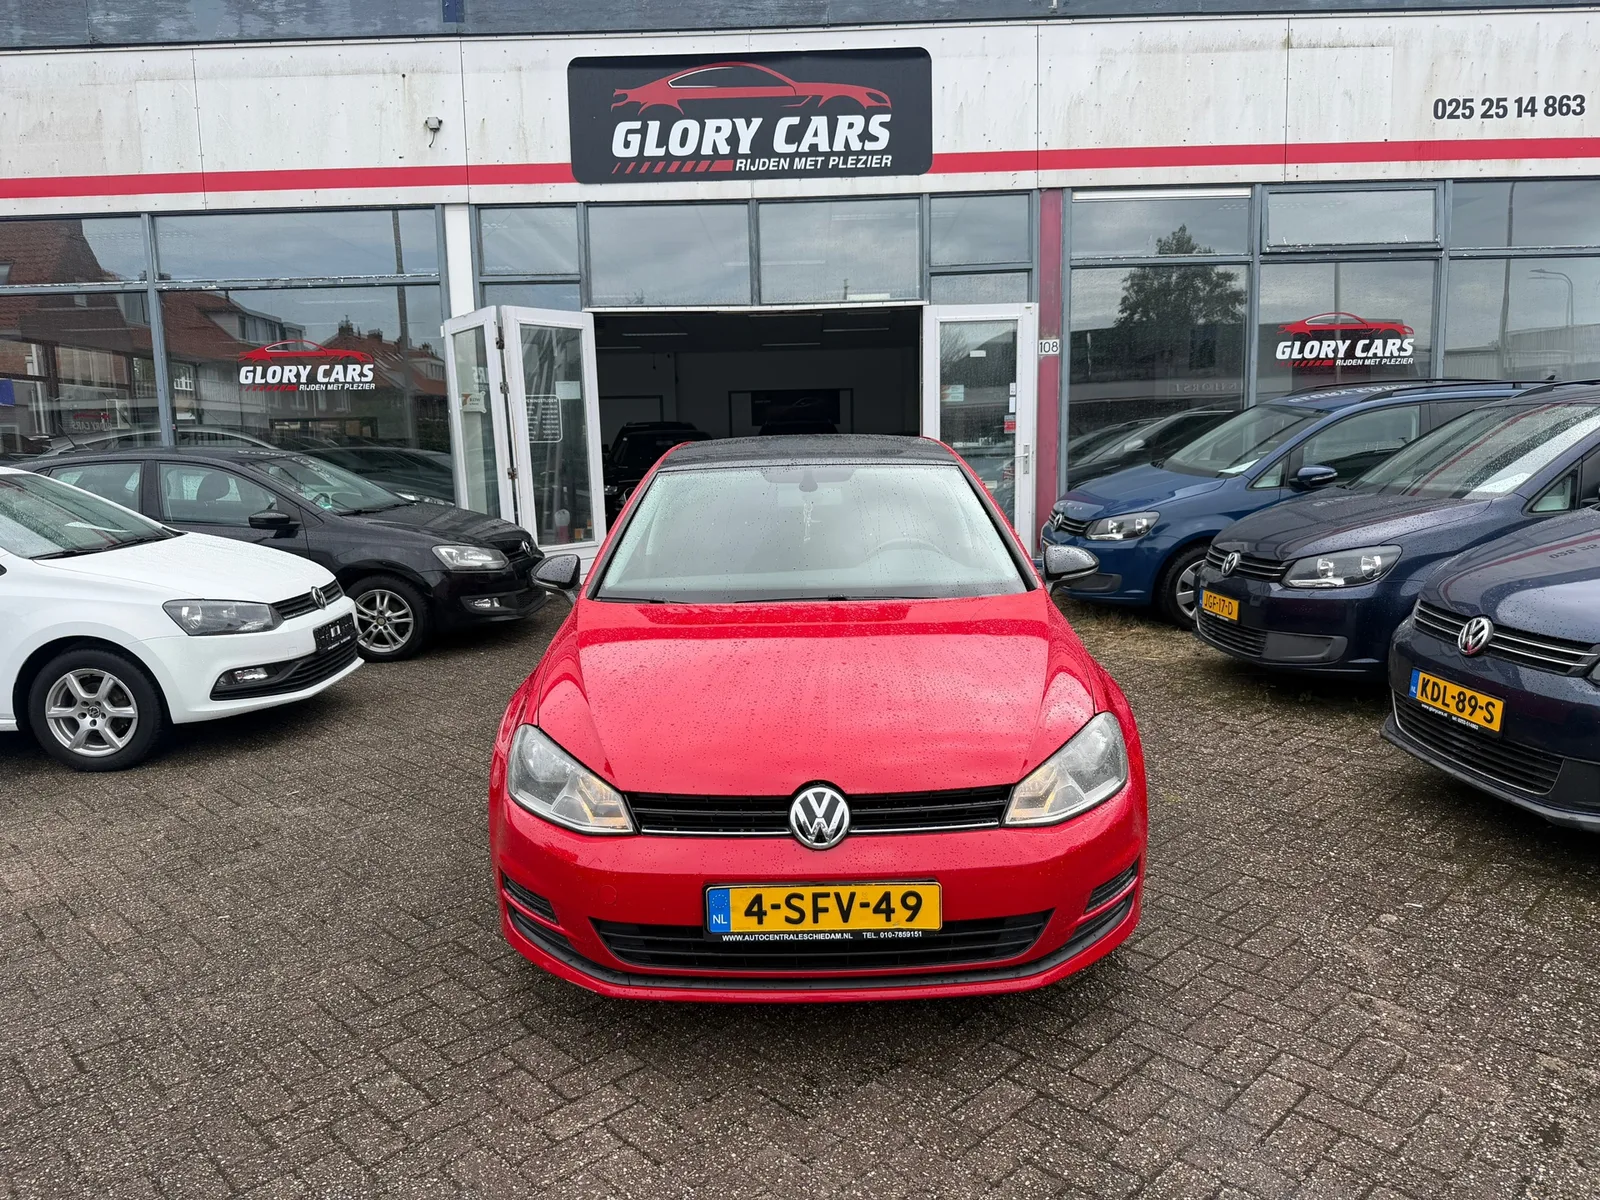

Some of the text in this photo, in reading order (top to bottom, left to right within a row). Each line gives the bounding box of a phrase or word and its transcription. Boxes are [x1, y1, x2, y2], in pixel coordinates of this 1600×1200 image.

[1433, 94, 1586, 120] 025 25 14 863
[611, 114, 892, 158] GLORY CARS
[735, 155, 893, 172] RIJDEN MET PLEZIER
[1039, 341, 1059, 354] 108
[1275, 338, 1415, 360] GLORY CARS
[1335, 357, 1414, 367] RIJDEN MET PLEZIER
[239, 364, 374, 385] GLORY CARS
[1420, 677, 1496, 724] KDL-89-S
[790, 787, 849, 849] VW
[743, 890, 923, 925] 4-SFV-49
[712, 914, 728, 925] NL
[722, 930, 923, 942] WWW.AUTOCENTRALESCHIEDAM.NL TEL. 010-7859151
